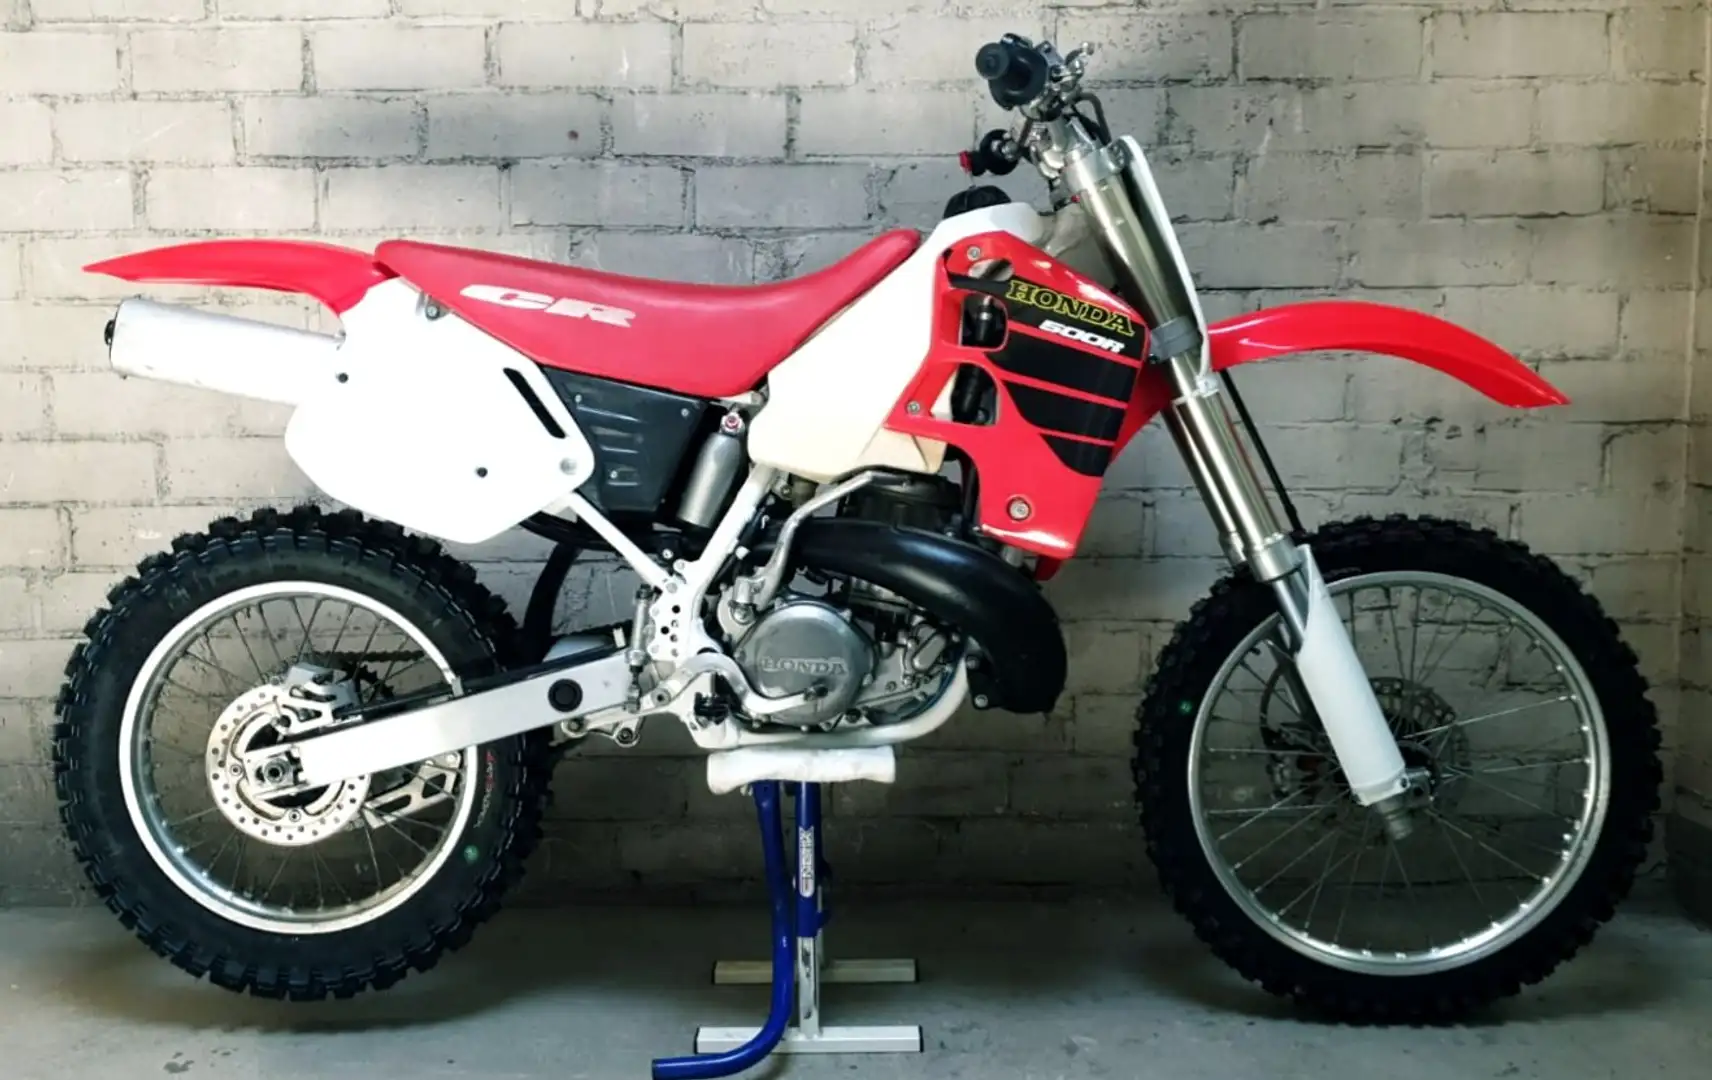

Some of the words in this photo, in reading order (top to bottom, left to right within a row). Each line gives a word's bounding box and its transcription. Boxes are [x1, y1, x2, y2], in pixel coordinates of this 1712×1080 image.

[459, 283, 637, 328] CR
[1006, 279, 1135, 337] HONDA
[1038, 319, 1125, 353] 500R
[761, 656, 850, 676] HONDA
